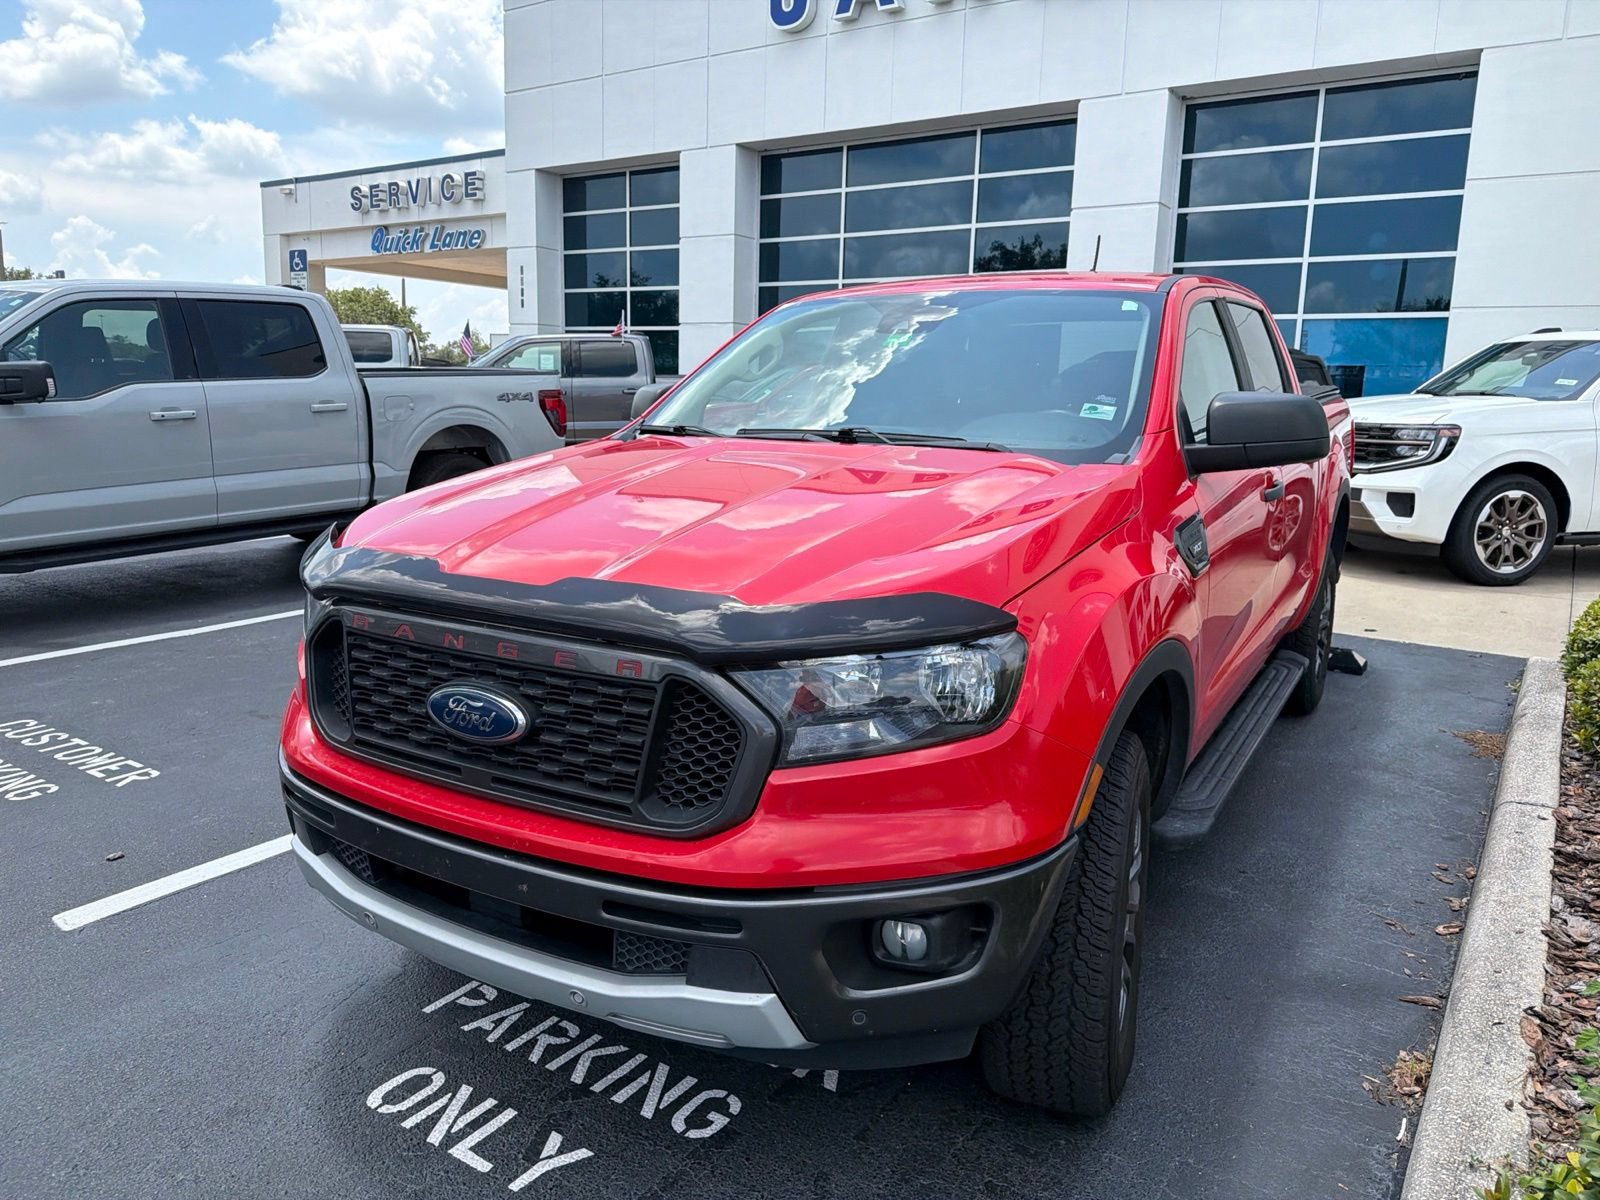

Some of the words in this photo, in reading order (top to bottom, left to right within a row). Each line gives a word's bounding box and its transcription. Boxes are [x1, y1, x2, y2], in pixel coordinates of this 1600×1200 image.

[350, 170, 485, 213] SERVICE
[370, 225, 429, 254] Quick
[429, 224, 486, 251] Lane
[351, 613, 644, 680] RANGER
[443, 695, 497, 732] Ford
[0, 719, 161, 788] CUSTOMER
[421, 980, 743, 1139] PARKING
[366, 1066, 595, 1192] ONLY
